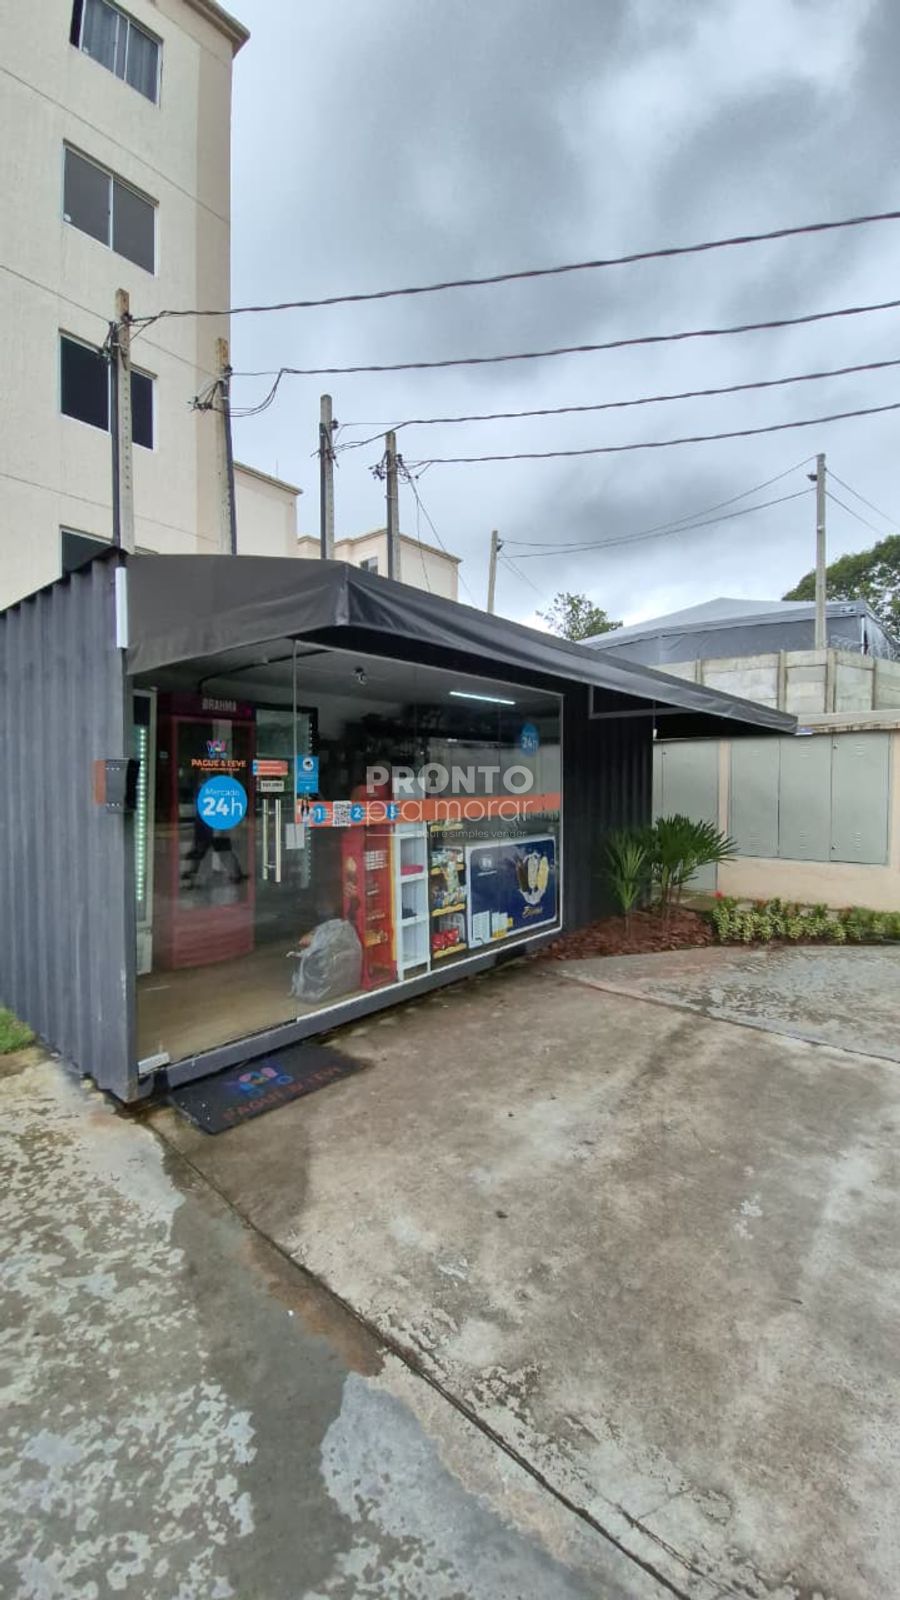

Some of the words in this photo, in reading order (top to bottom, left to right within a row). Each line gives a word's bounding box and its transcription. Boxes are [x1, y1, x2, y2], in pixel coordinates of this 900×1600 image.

[191, 759, 219, 767] PAGUE
[206, 787, 240, 796] Mercado
[203, 797, 243, 816] 24h
